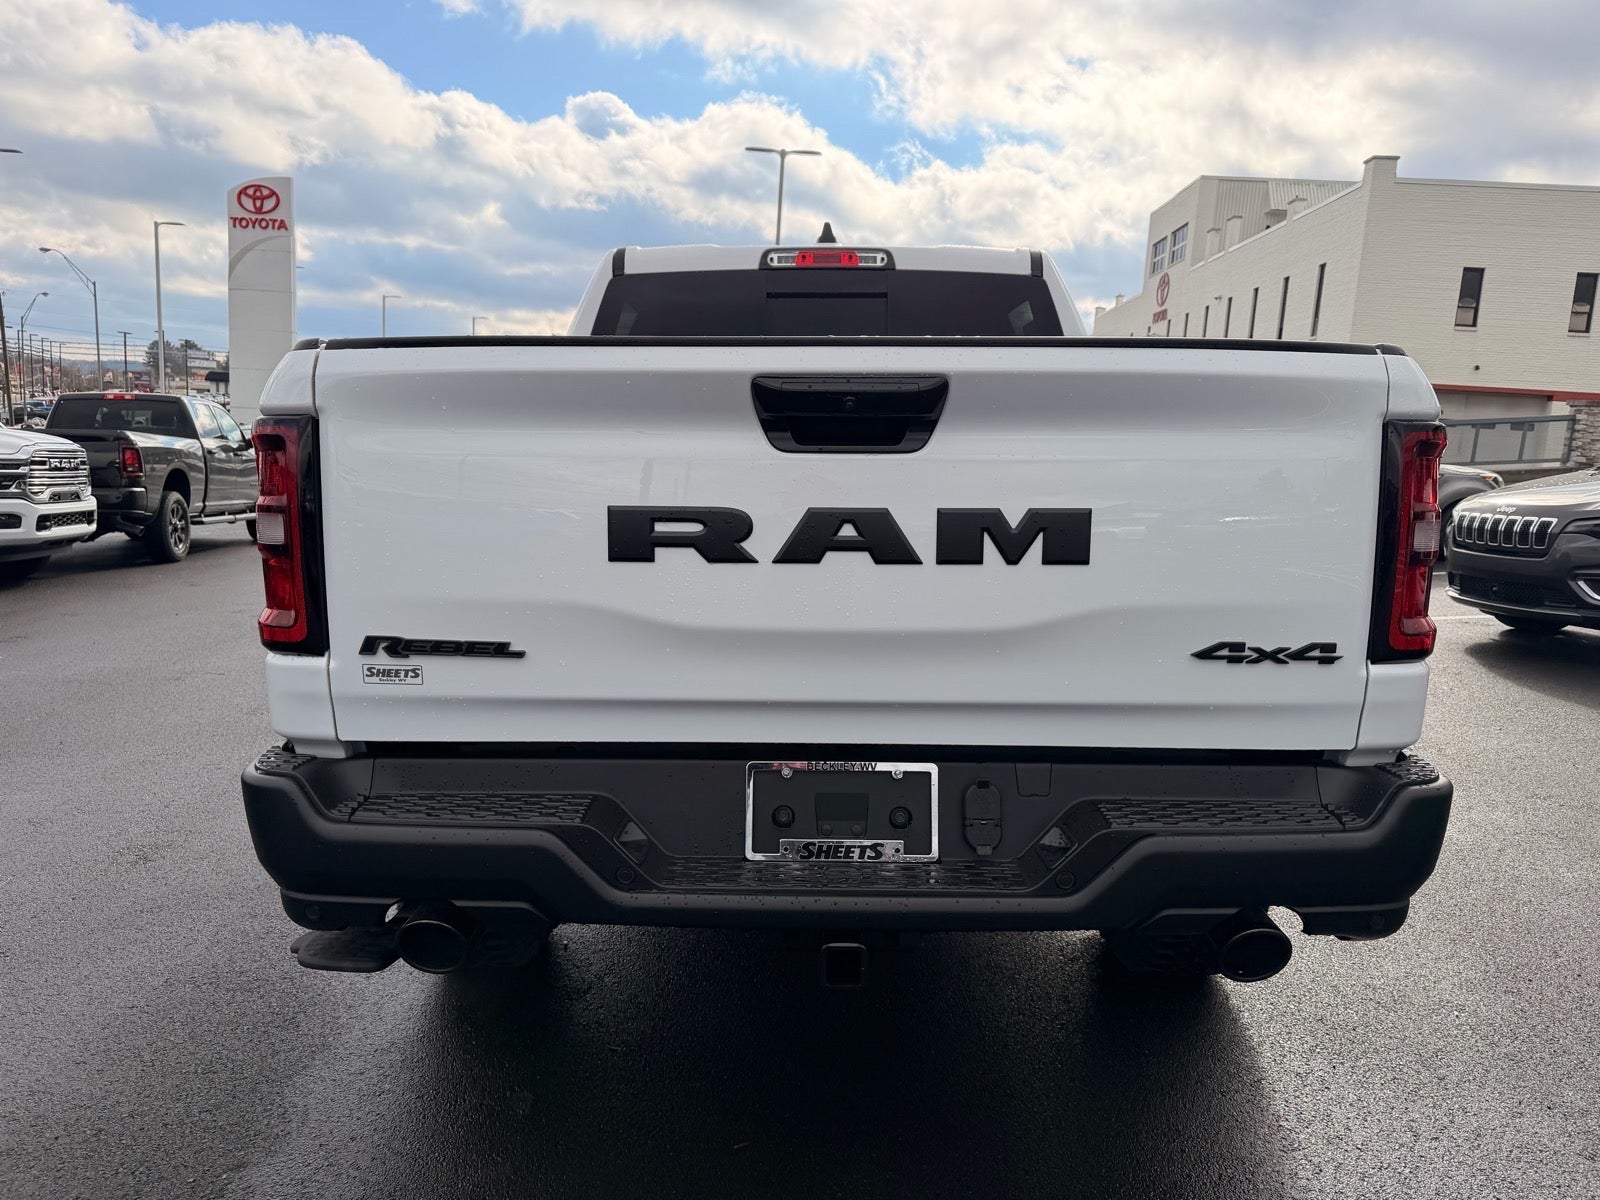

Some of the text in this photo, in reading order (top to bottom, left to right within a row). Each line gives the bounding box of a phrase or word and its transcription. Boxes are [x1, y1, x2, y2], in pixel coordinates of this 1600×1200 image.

[230, 216, 288, 231] TOYOTA
[607, 505, 1092, 566] RAM
[358, 635, 526, 659] REBEL
[365, 666, 421, 678] SHEETS
[799, 842, 885, 860] SHEETS
